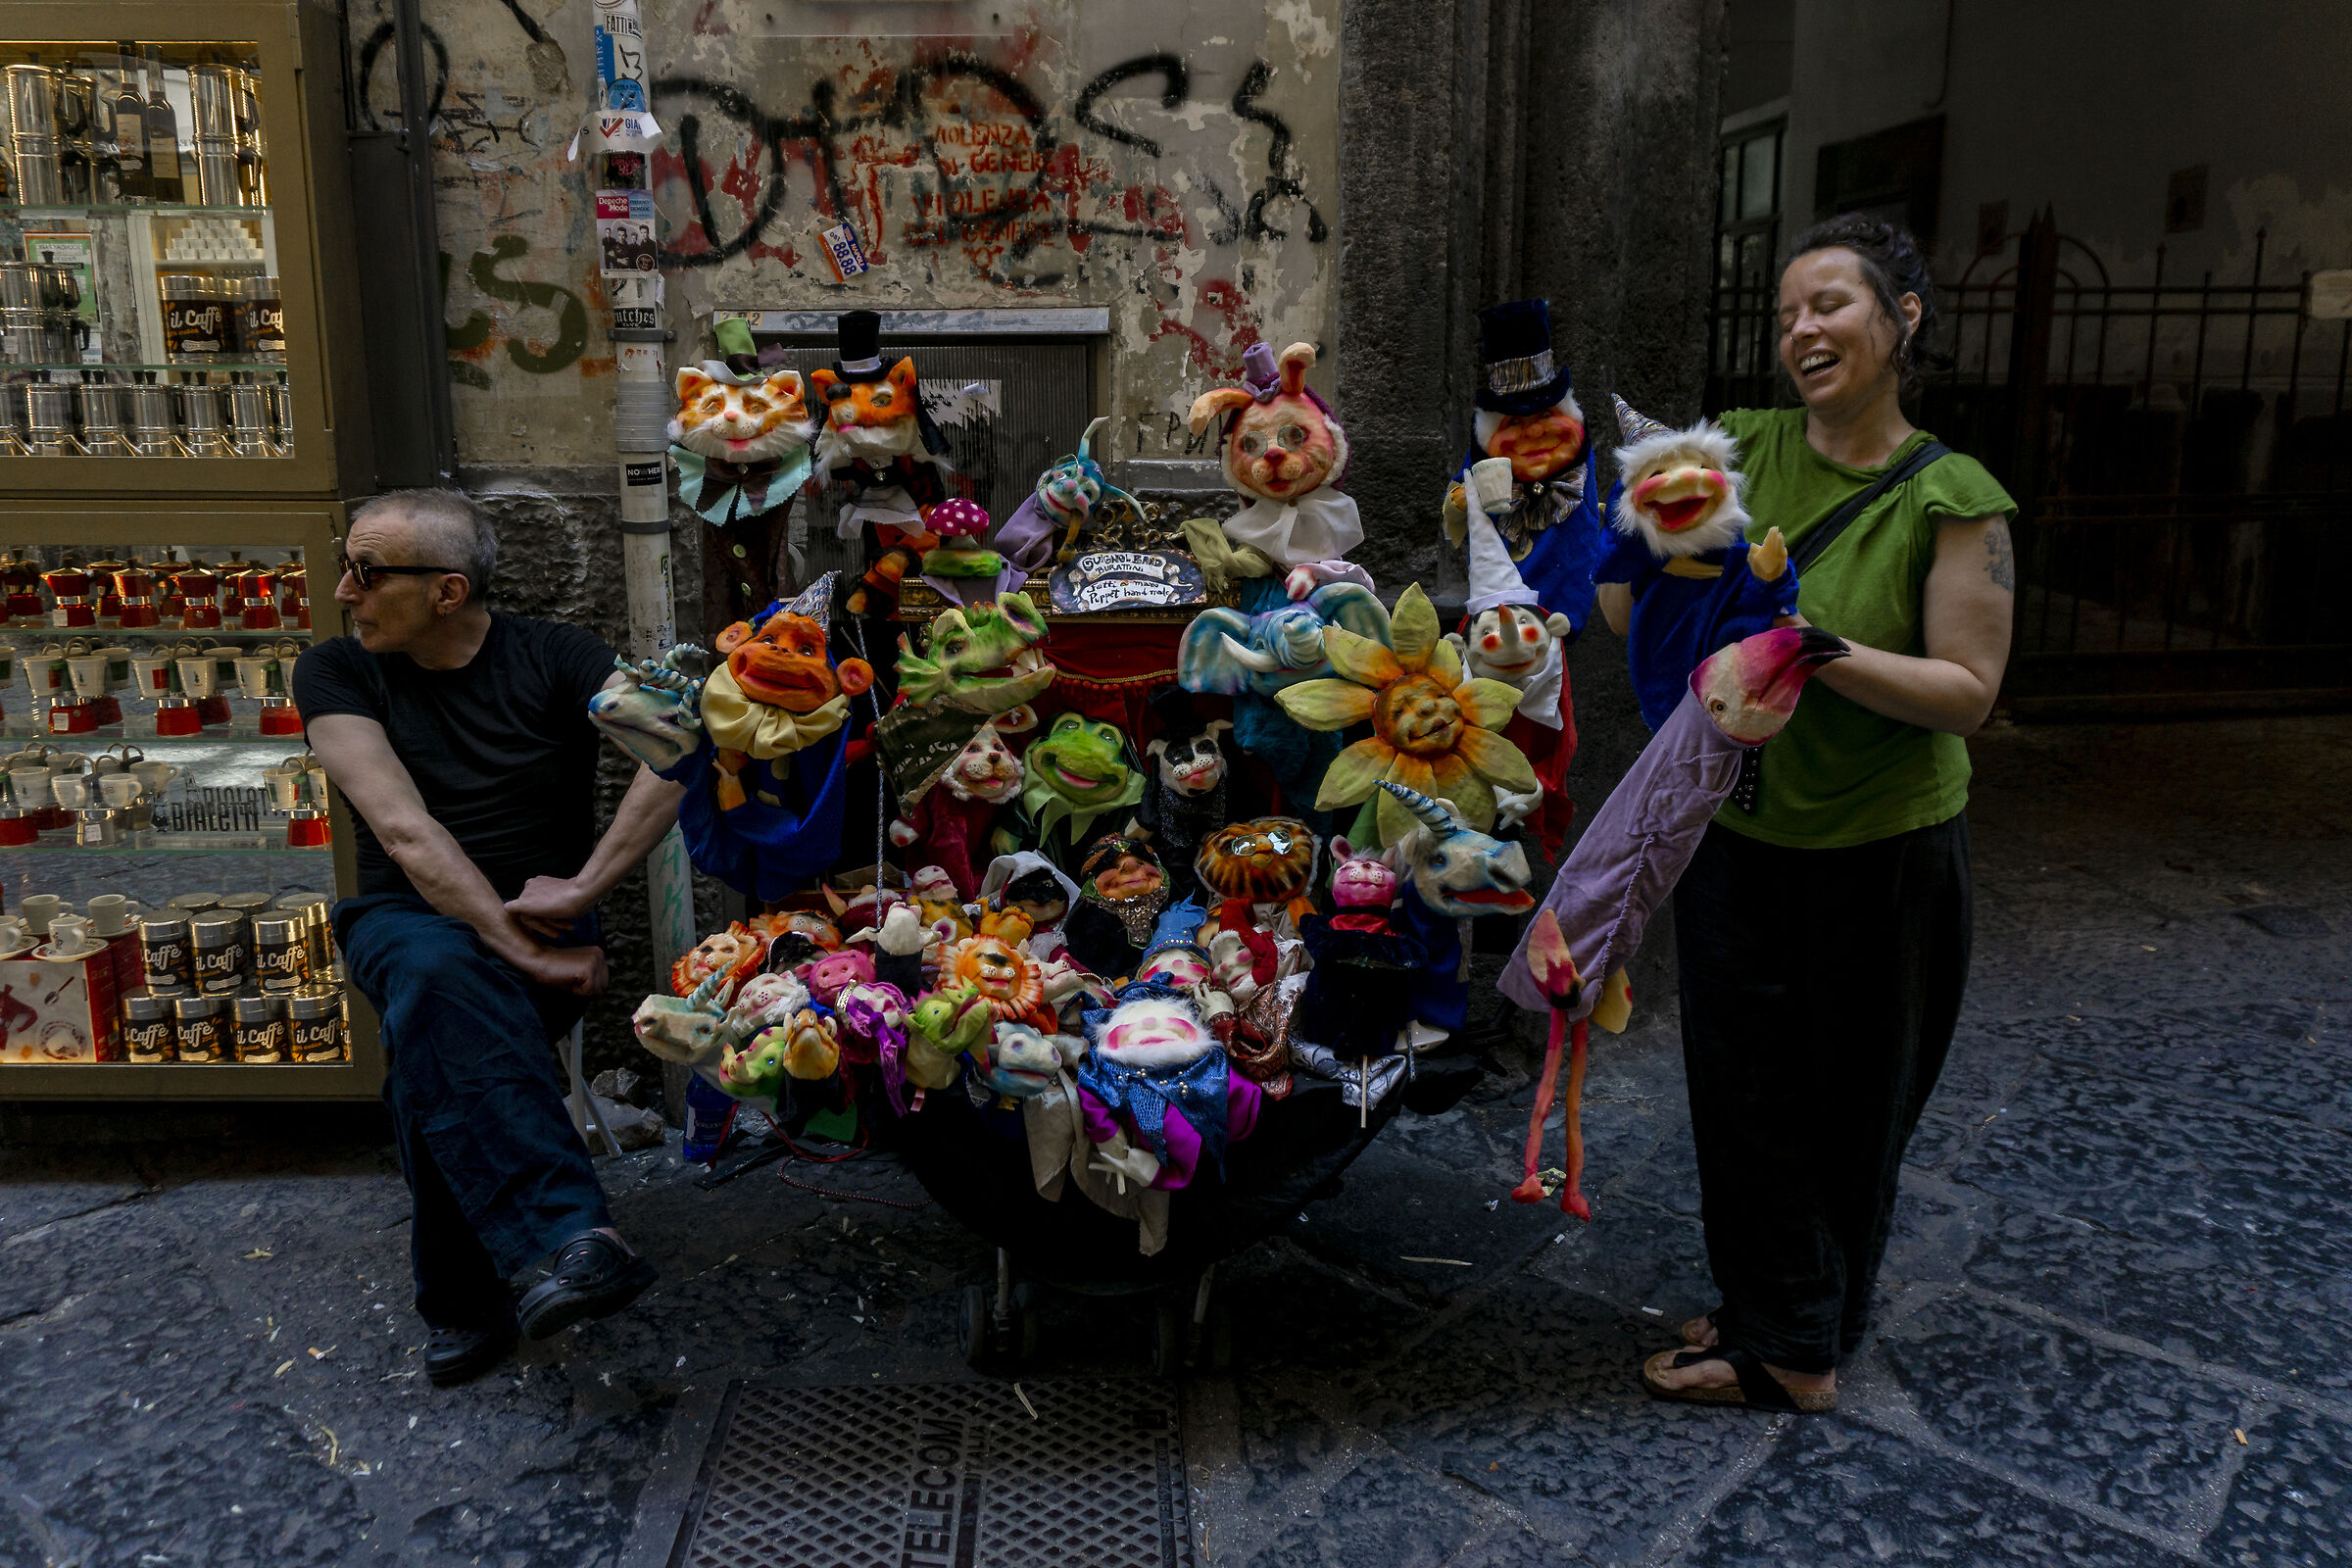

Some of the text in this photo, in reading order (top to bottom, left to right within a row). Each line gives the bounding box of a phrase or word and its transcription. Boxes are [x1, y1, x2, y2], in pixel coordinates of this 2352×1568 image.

[598, 197, 627, 206] Depeche
[833, 241, 858, 274] 88.88
[850, 243, 864, 267] NAPOLI
[170, 312, 184, 329] il
[1095, 564, 1144, 575] BURATTINI
[1089, 589, 1120, 605] Puppet
[144, 944, 182, 971] Caffè
[195, 944, 245, 972] il Caffè
[257, 945, 306, 972] il Caffè
[130, 1022, 170, 1050] Caffè
[236, 1029, 247, 1045] il
[296, 1027, 309, 1044] il
[901, 1417, 964, 1568] TELECOM
